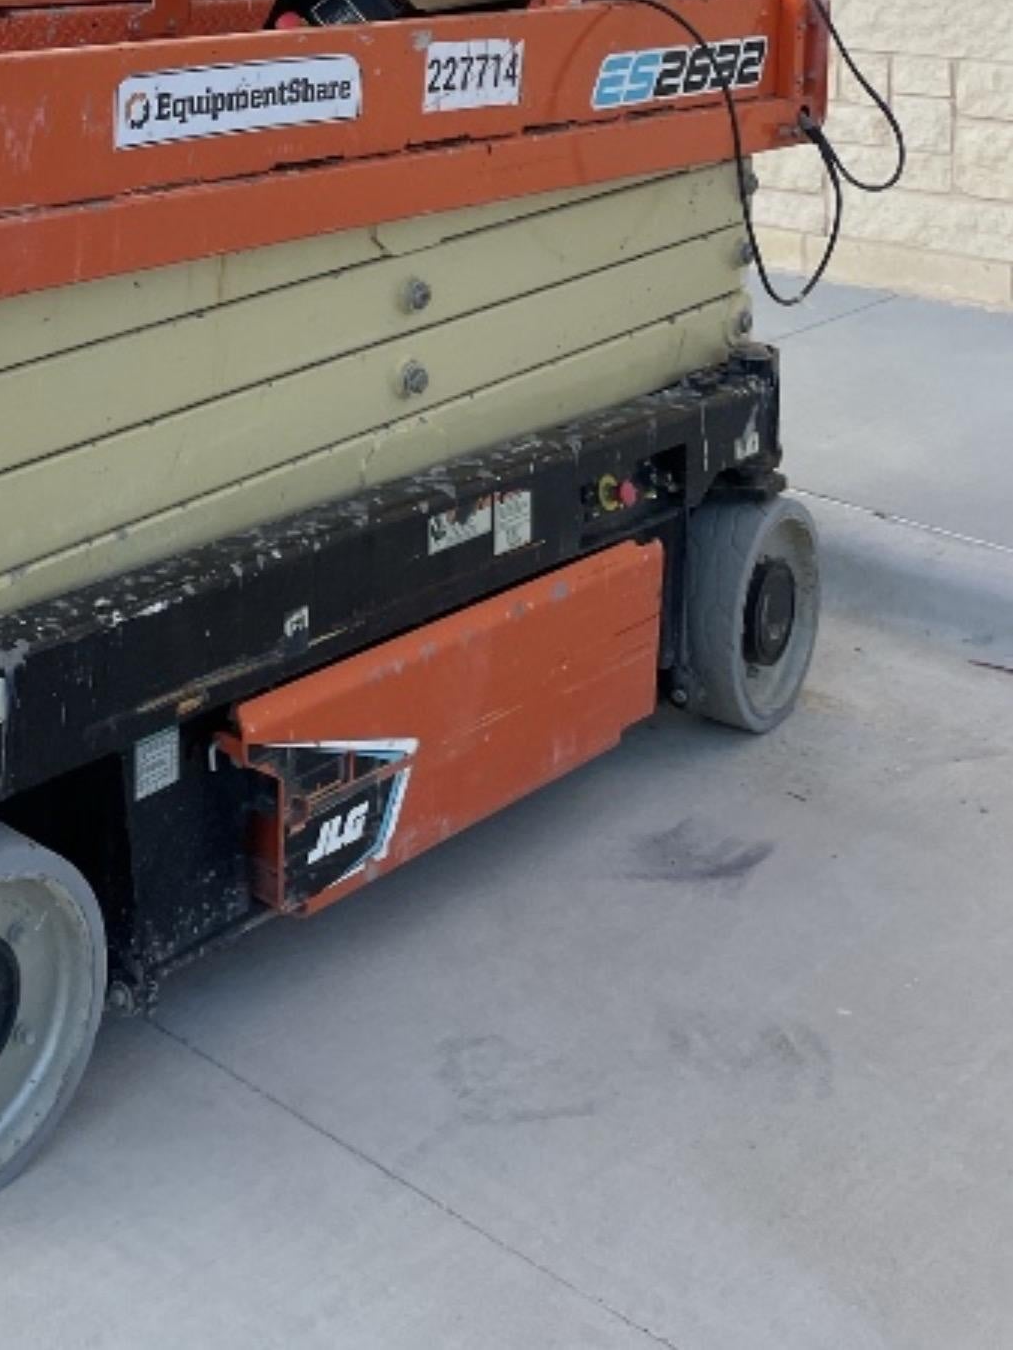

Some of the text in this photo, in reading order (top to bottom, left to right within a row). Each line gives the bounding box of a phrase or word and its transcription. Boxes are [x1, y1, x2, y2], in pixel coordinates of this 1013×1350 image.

[154, 77, 352, 124] EquipmentShare
[426, 52, 520, 95] 227714
[593, 38, 767, 108] ES2632
[307, 799, 370, 866] JLG
